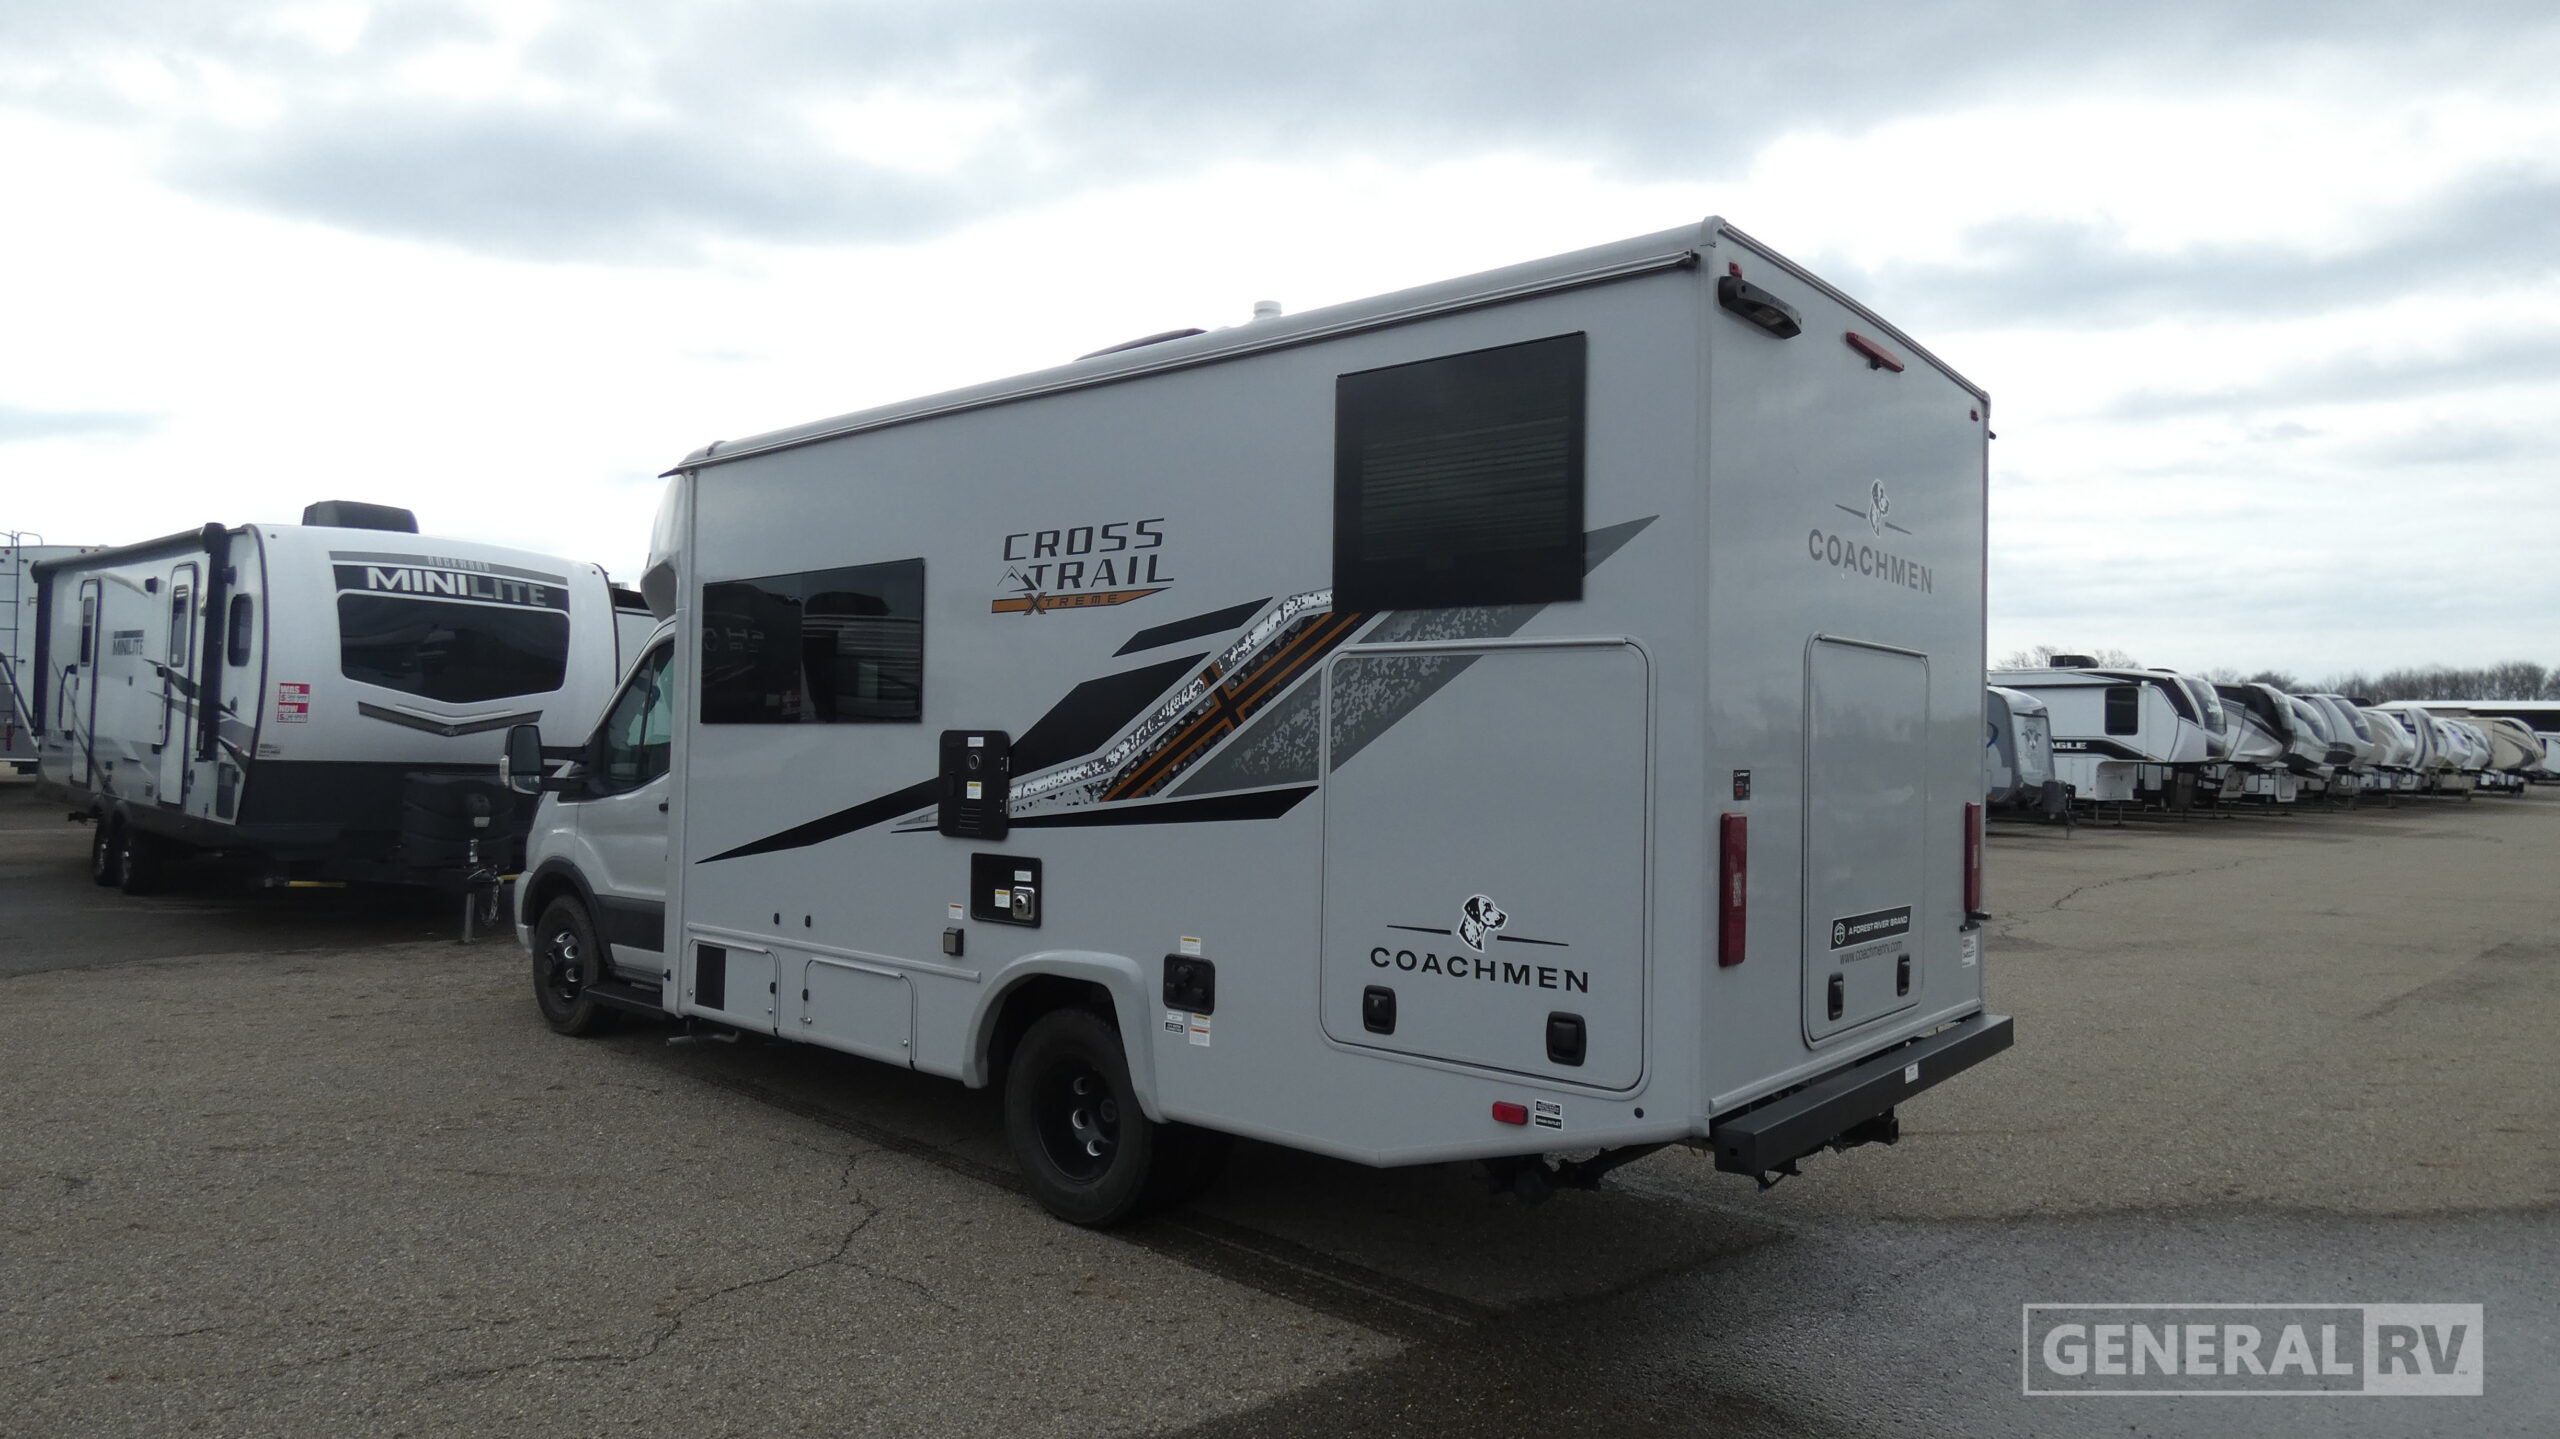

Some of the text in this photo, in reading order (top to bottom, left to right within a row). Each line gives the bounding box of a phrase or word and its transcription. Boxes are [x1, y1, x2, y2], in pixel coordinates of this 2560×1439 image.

[1003, 518, 1165, 561] CROSS
[1028, 554, 1174, 590] TRAIL
[1808, 528, 1932, 594] COACHMEN
[366, 567, 546, 607] MINILITE
[1024, 592, 1118, 615] XTREME
[2052, 742, 2087, 750] AGLE
[1848, 915, 1908, 935] A FOREST RIVER BRAND
[1370, 947, 1588, 993] COACHMEN
